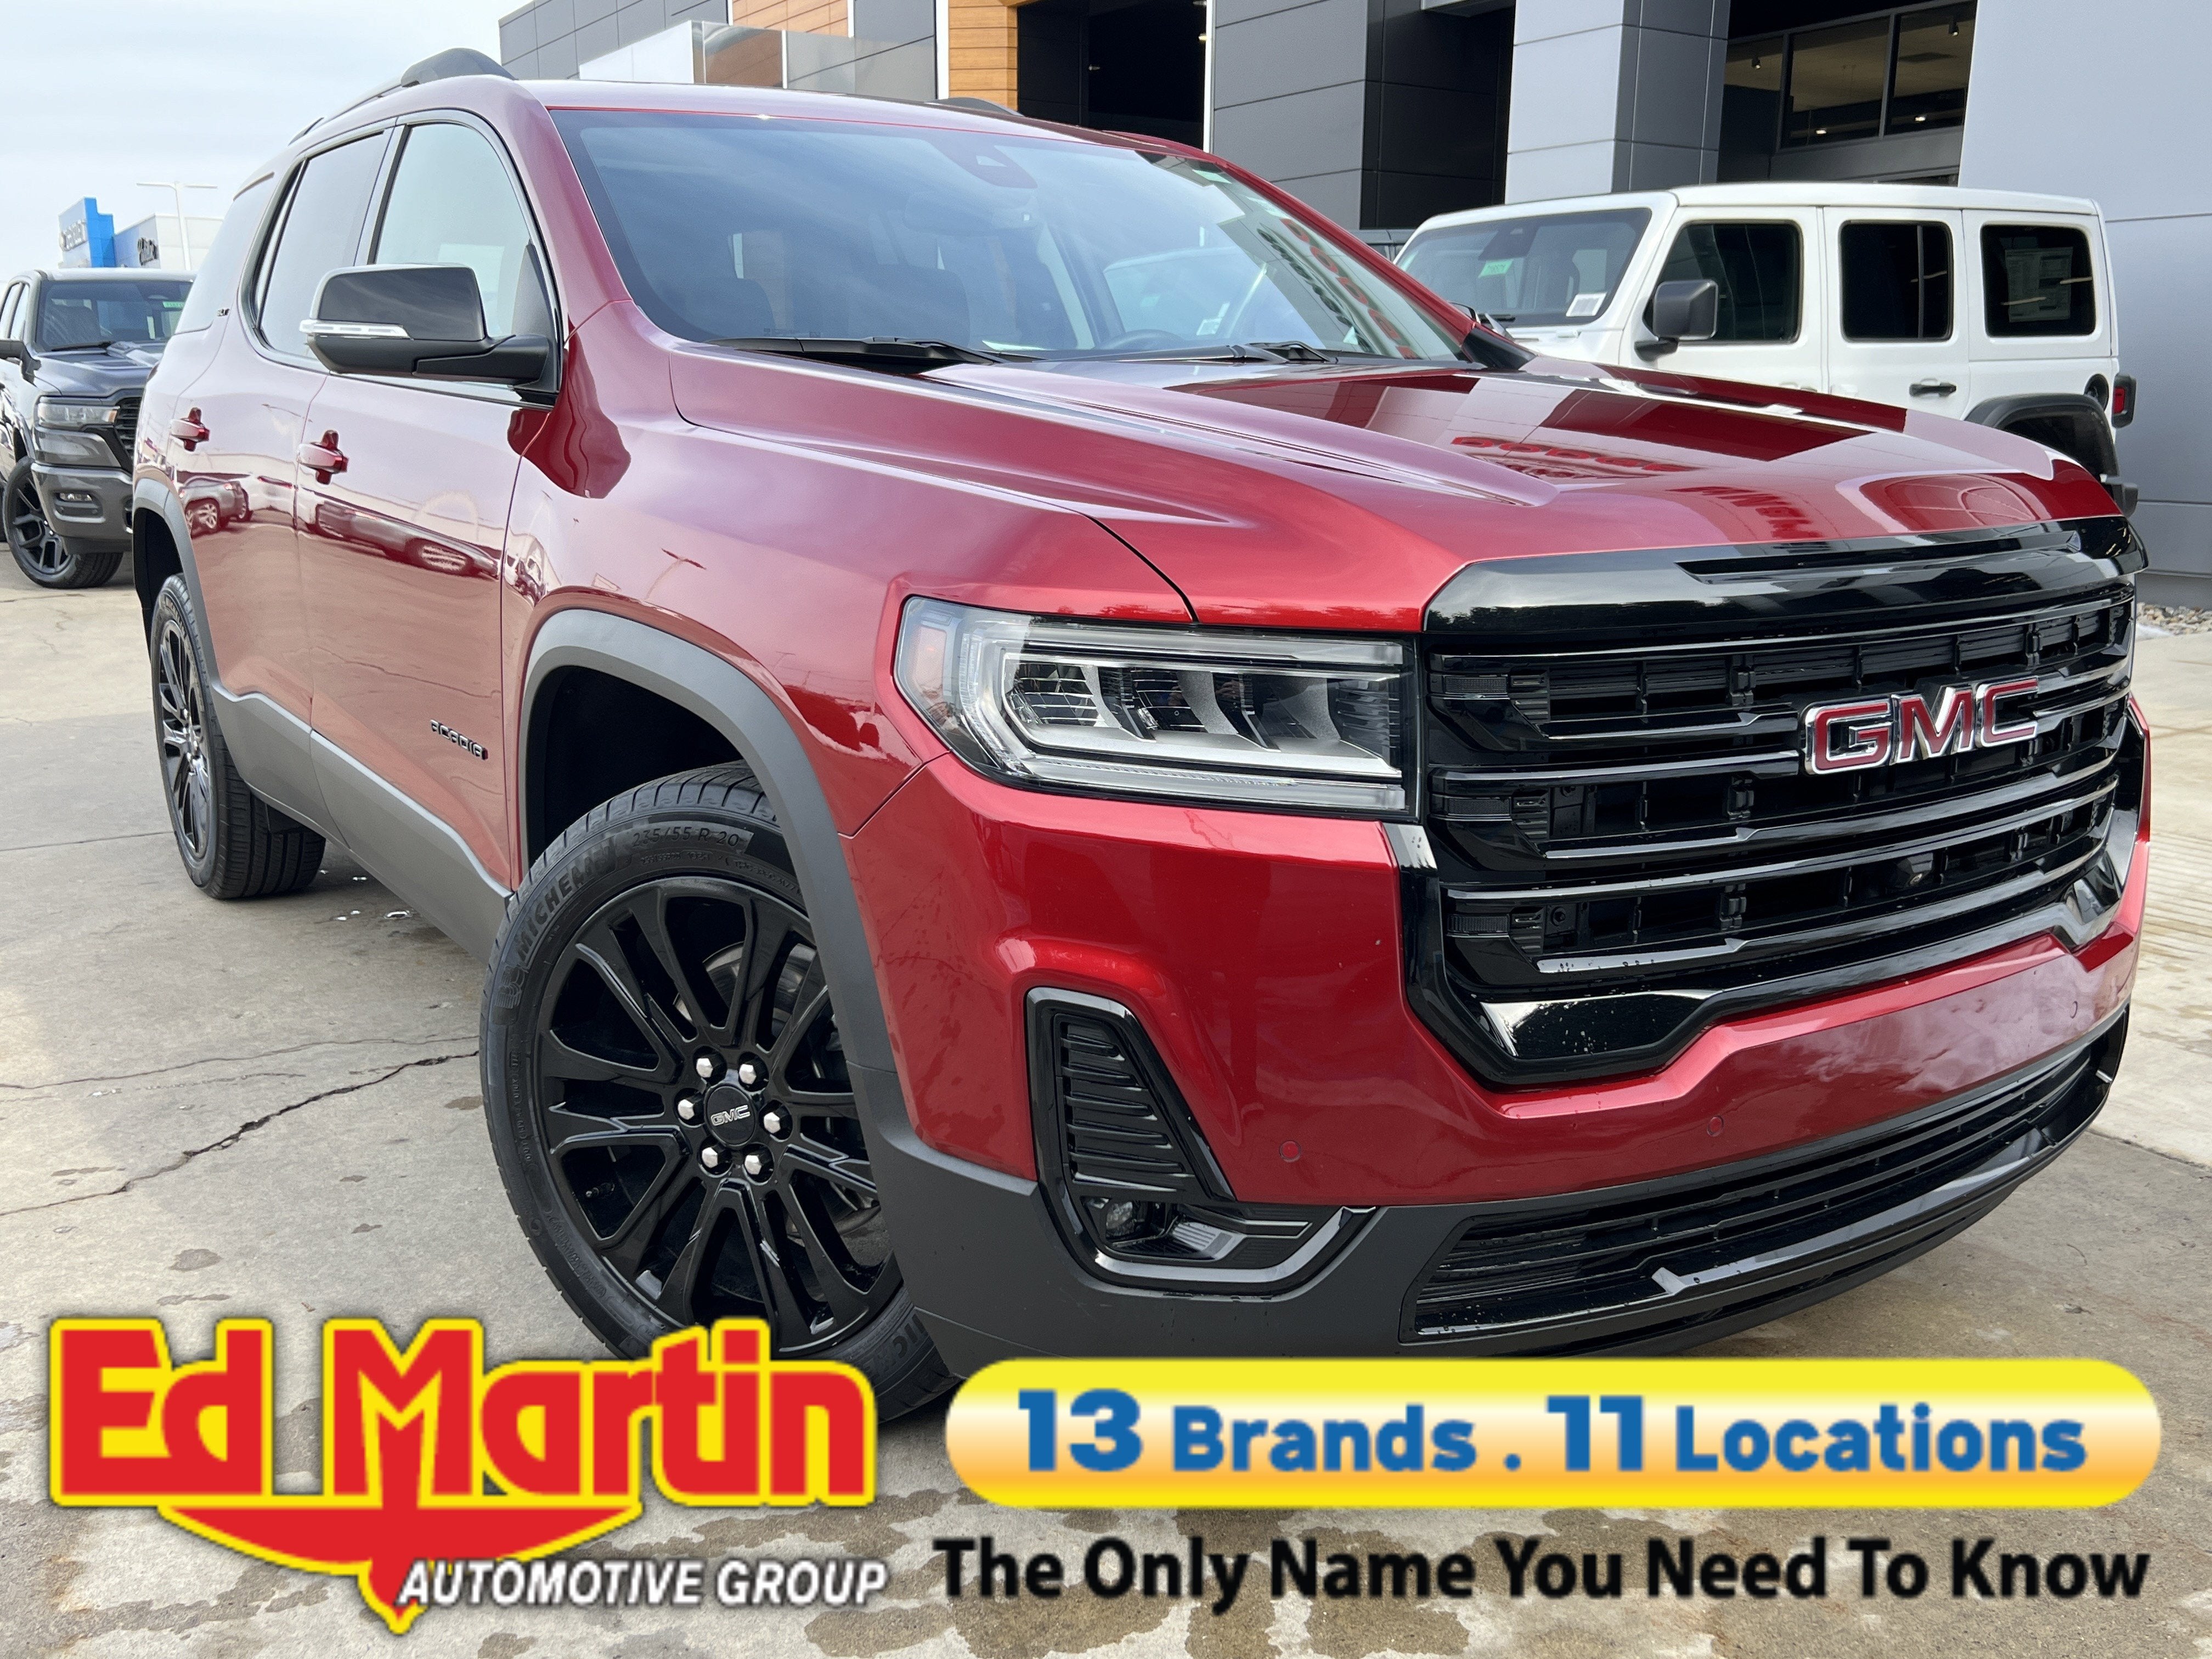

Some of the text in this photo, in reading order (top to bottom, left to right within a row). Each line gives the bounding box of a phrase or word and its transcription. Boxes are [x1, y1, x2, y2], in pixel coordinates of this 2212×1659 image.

[430, 719, 486, 760] ACADIA
[1804, 676, 2039, 775] GMC
[632, 826, 740, 848] 235/55 R 20
[517, 837, 618, 963] MICHE
[710, 1104, 751, 1126] GMC
